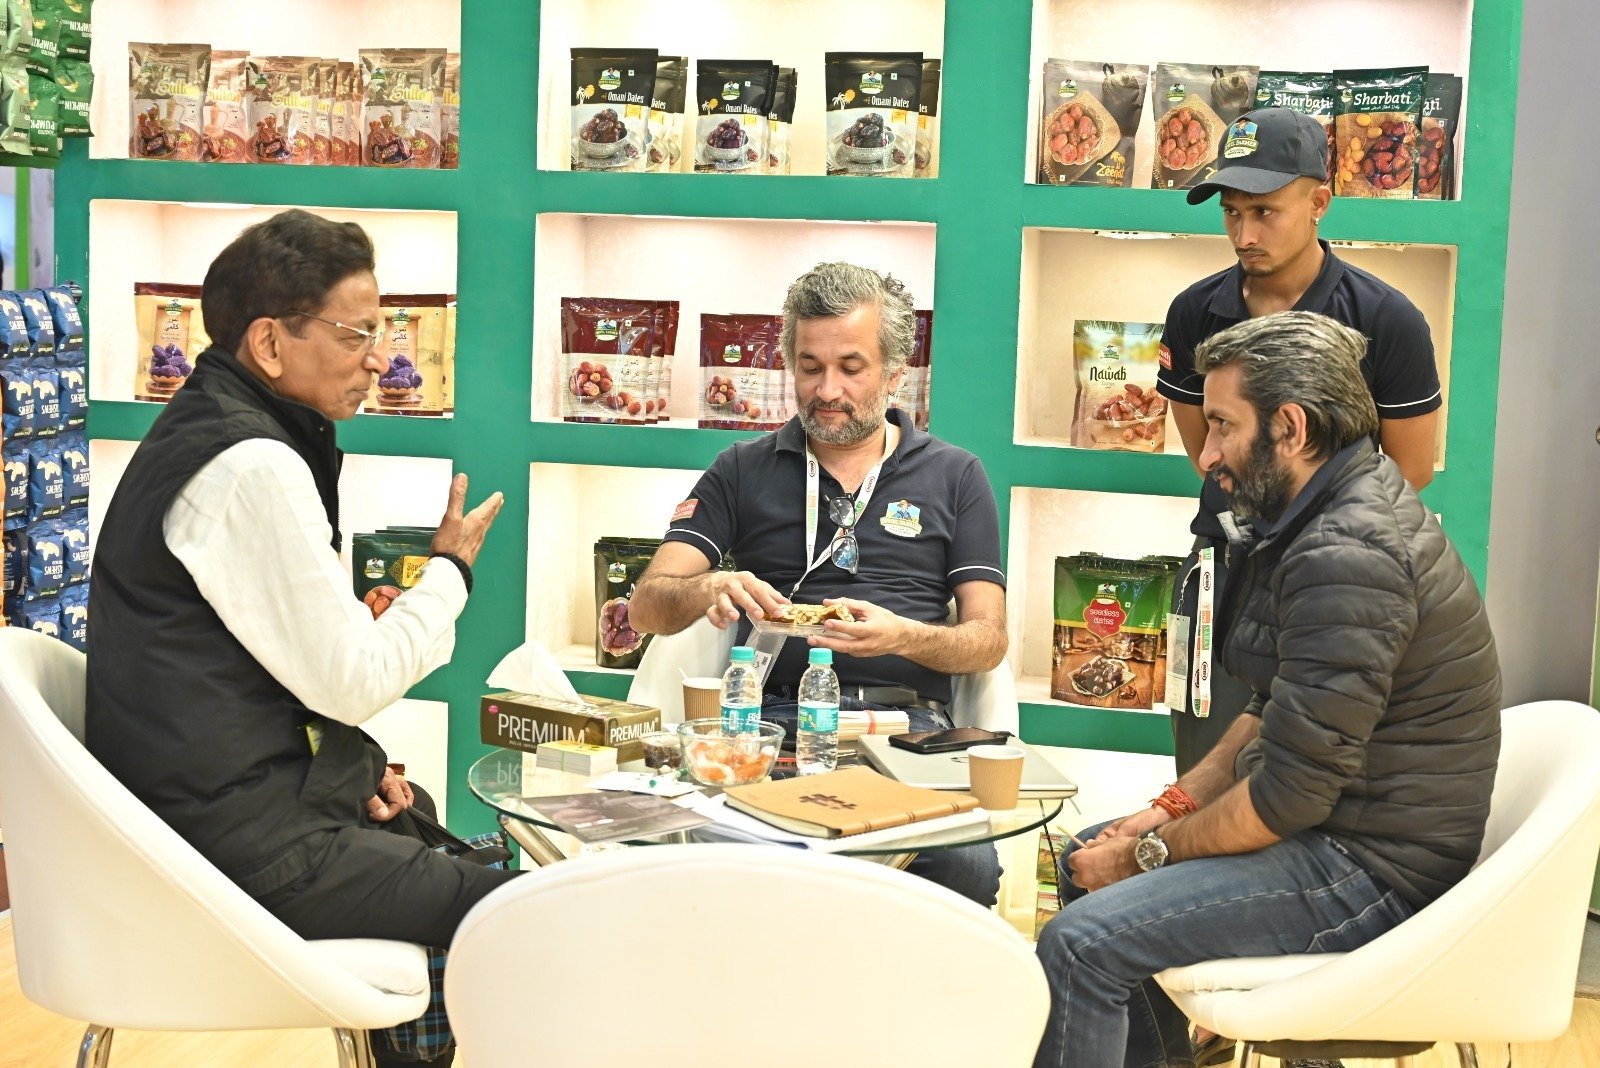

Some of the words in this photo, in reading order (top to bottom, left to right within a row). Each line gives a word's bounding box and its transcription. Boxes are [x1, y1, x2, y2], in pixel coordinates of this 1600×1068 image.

[607, 91, 627, 103] Omani
[627, 92, 645, 104] Dates
[651, 98, 667, 110] Dates
[871, 96, 892, 106] Omani
[892, 97, 910, 108] Dates
[1353, 91, 1413, 106] Sharbati
[725, 103, 742, 113] Omani
[743, 104, 758, 114] Dates
[1090, 366, 1127, 381] Nawab
[498, 713, 586, 744] PREMIUM
[609, 720, 656, 744] PREMIUM
